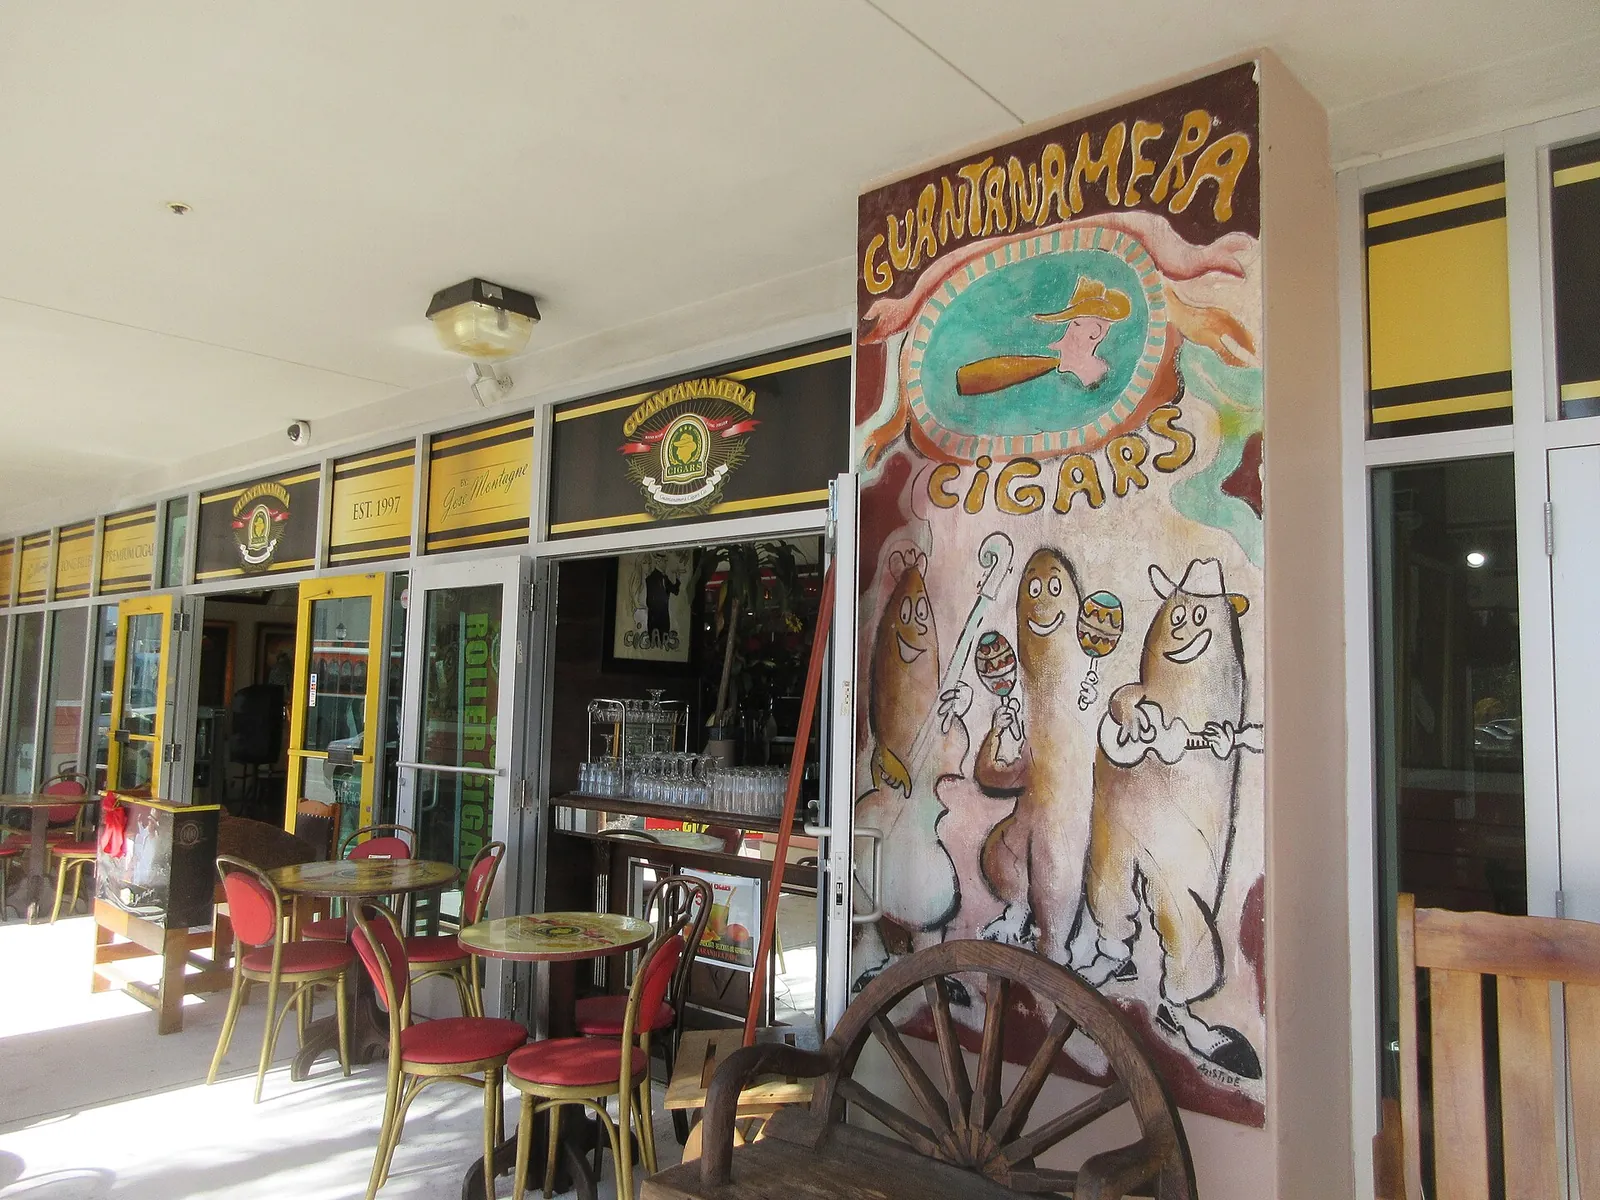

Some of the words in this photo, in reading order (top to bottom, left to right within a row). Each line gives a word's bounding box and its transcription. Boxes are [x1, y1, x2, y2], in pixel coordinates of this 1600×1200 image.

[862, 108, 1251, 296] GUANTANAMERA
[622, 377, 757, 437] GUANTANAMERA
[470, 463, 530, 502] Montagne
[667, 462, 702, 476] CIGARS
[352, 500, 374, 521] EST.
[376, 496, 401, 517] 1997
[624, 628, 680, 652] CIGARS
[464, 613, 489, 751] ROLLER
